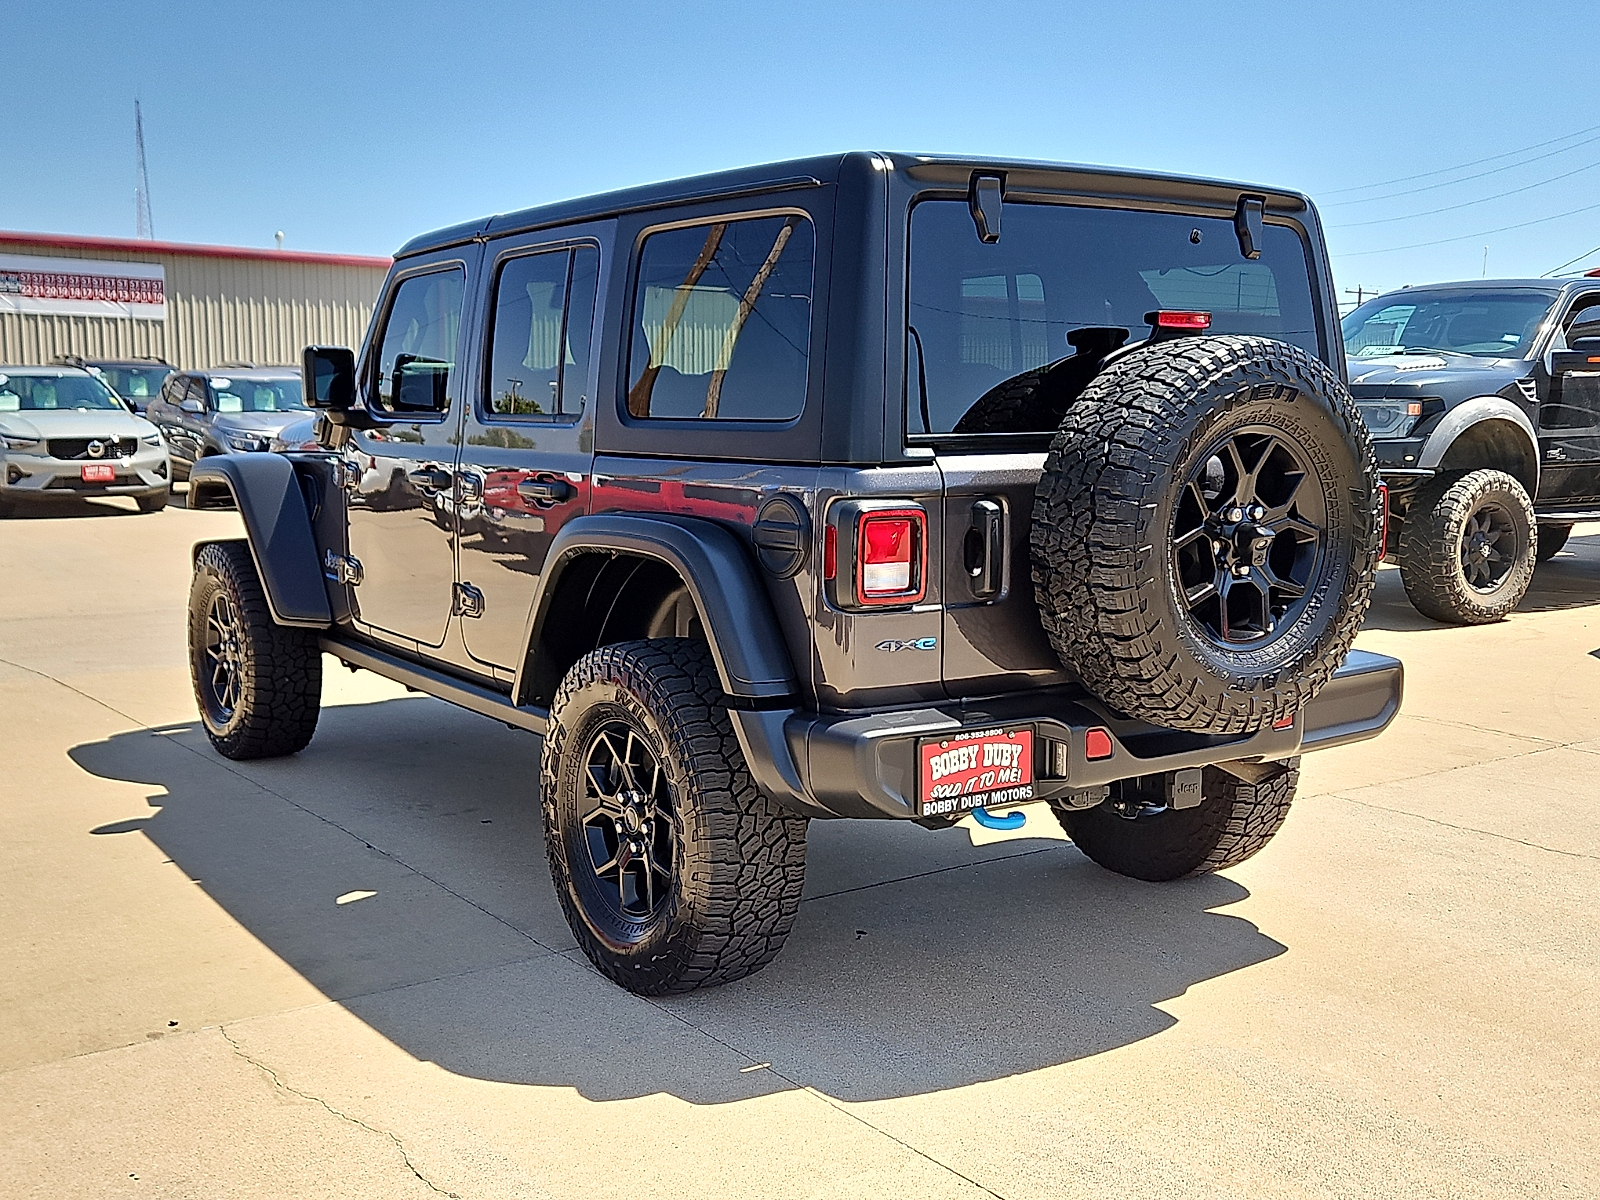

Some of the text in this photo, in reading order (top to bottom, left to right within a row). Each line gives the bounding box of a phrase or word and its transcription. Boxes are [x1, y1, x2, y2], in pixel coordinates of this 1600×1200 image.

[33, 285, 44, 294] 21
[119, 290, 129, 300] 13
[131, 291, 140, 301] 12
[142, 291, 151, 301] 11
[930, 742, 1023, 781] BOBBY DUBY
[930, 767, 1022, 799] SOLD IT TO ME!
[1177, 782, 1198, 794] Jeep
[923, 785, 1033, 816] BOBBY DUBY MOTORS
